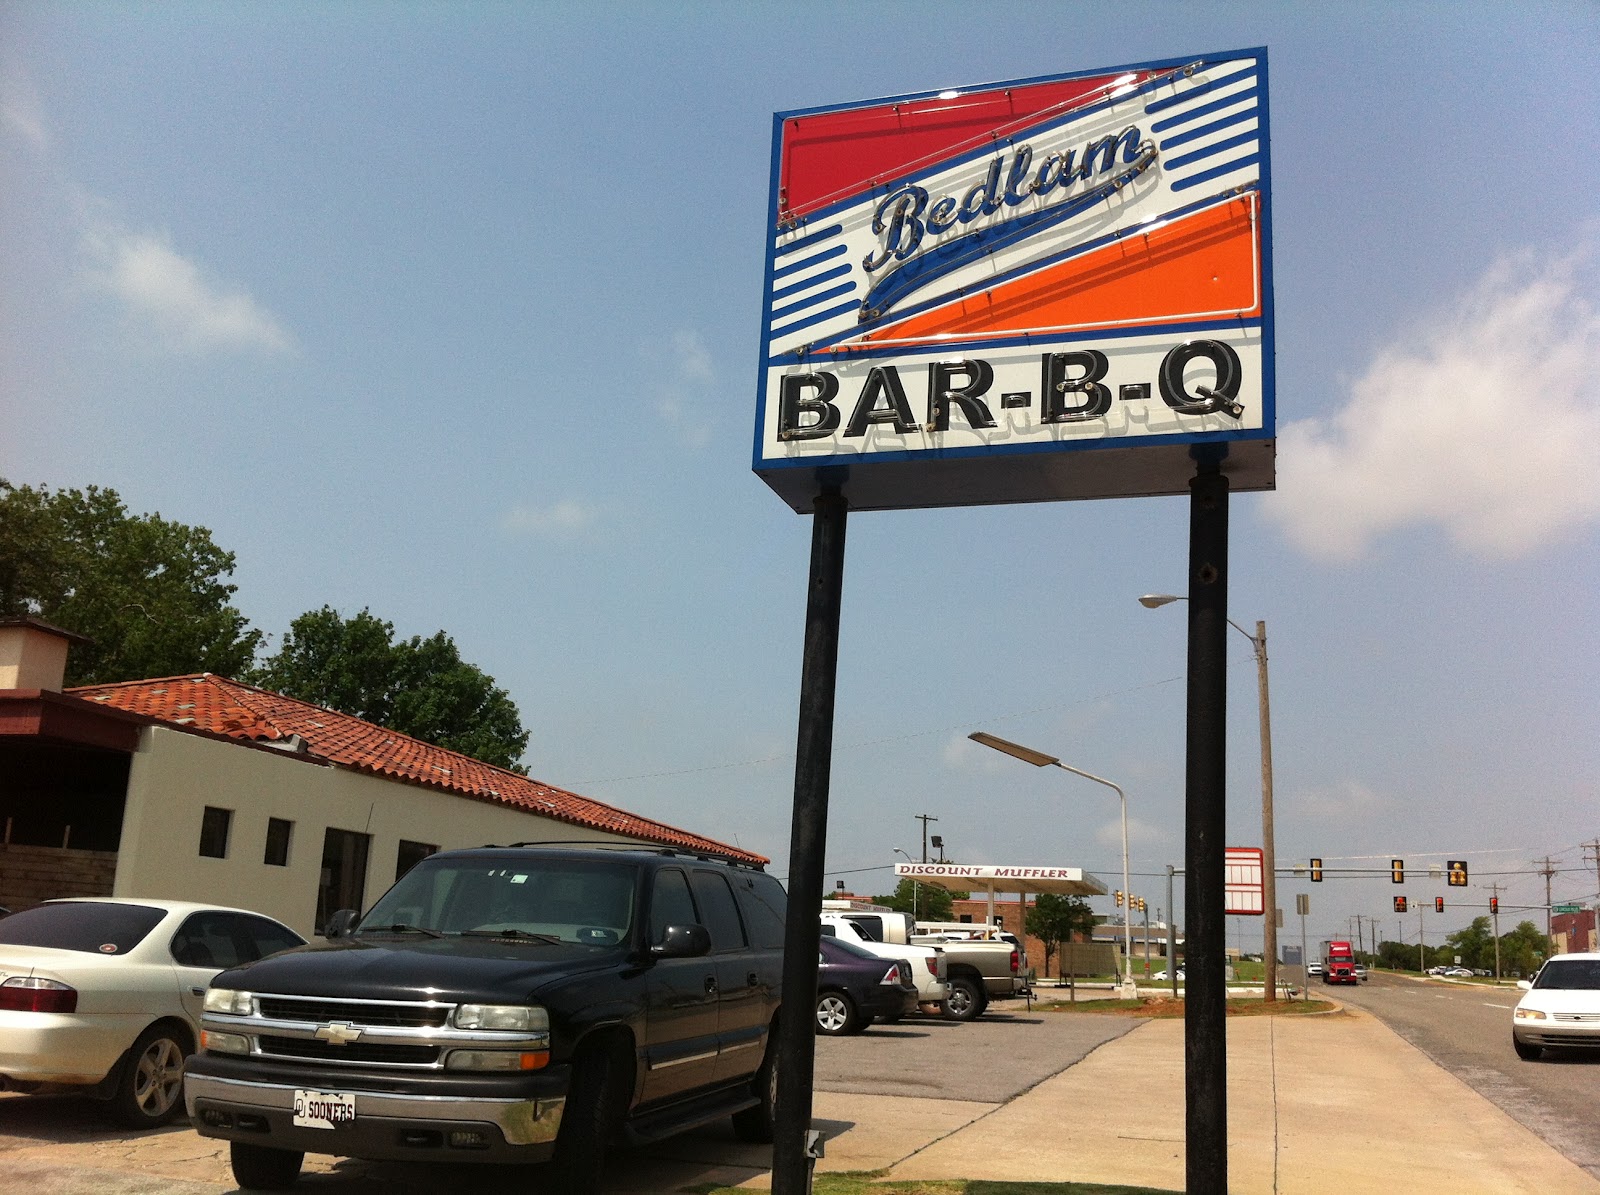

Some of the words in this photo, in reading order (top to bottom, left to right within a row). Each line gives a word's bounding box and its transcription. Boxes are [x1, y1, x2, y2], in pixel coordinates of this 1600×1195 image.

[862, 124, 1158, 273] Bedlam
[777, 339, 1245, 442] BAR-B-Q
[899, 865, 984, 876] DISCOUNT
[994, 868, 1069, 878] MUFFLER
[308, 1101, 354, 1121] SOONERS
